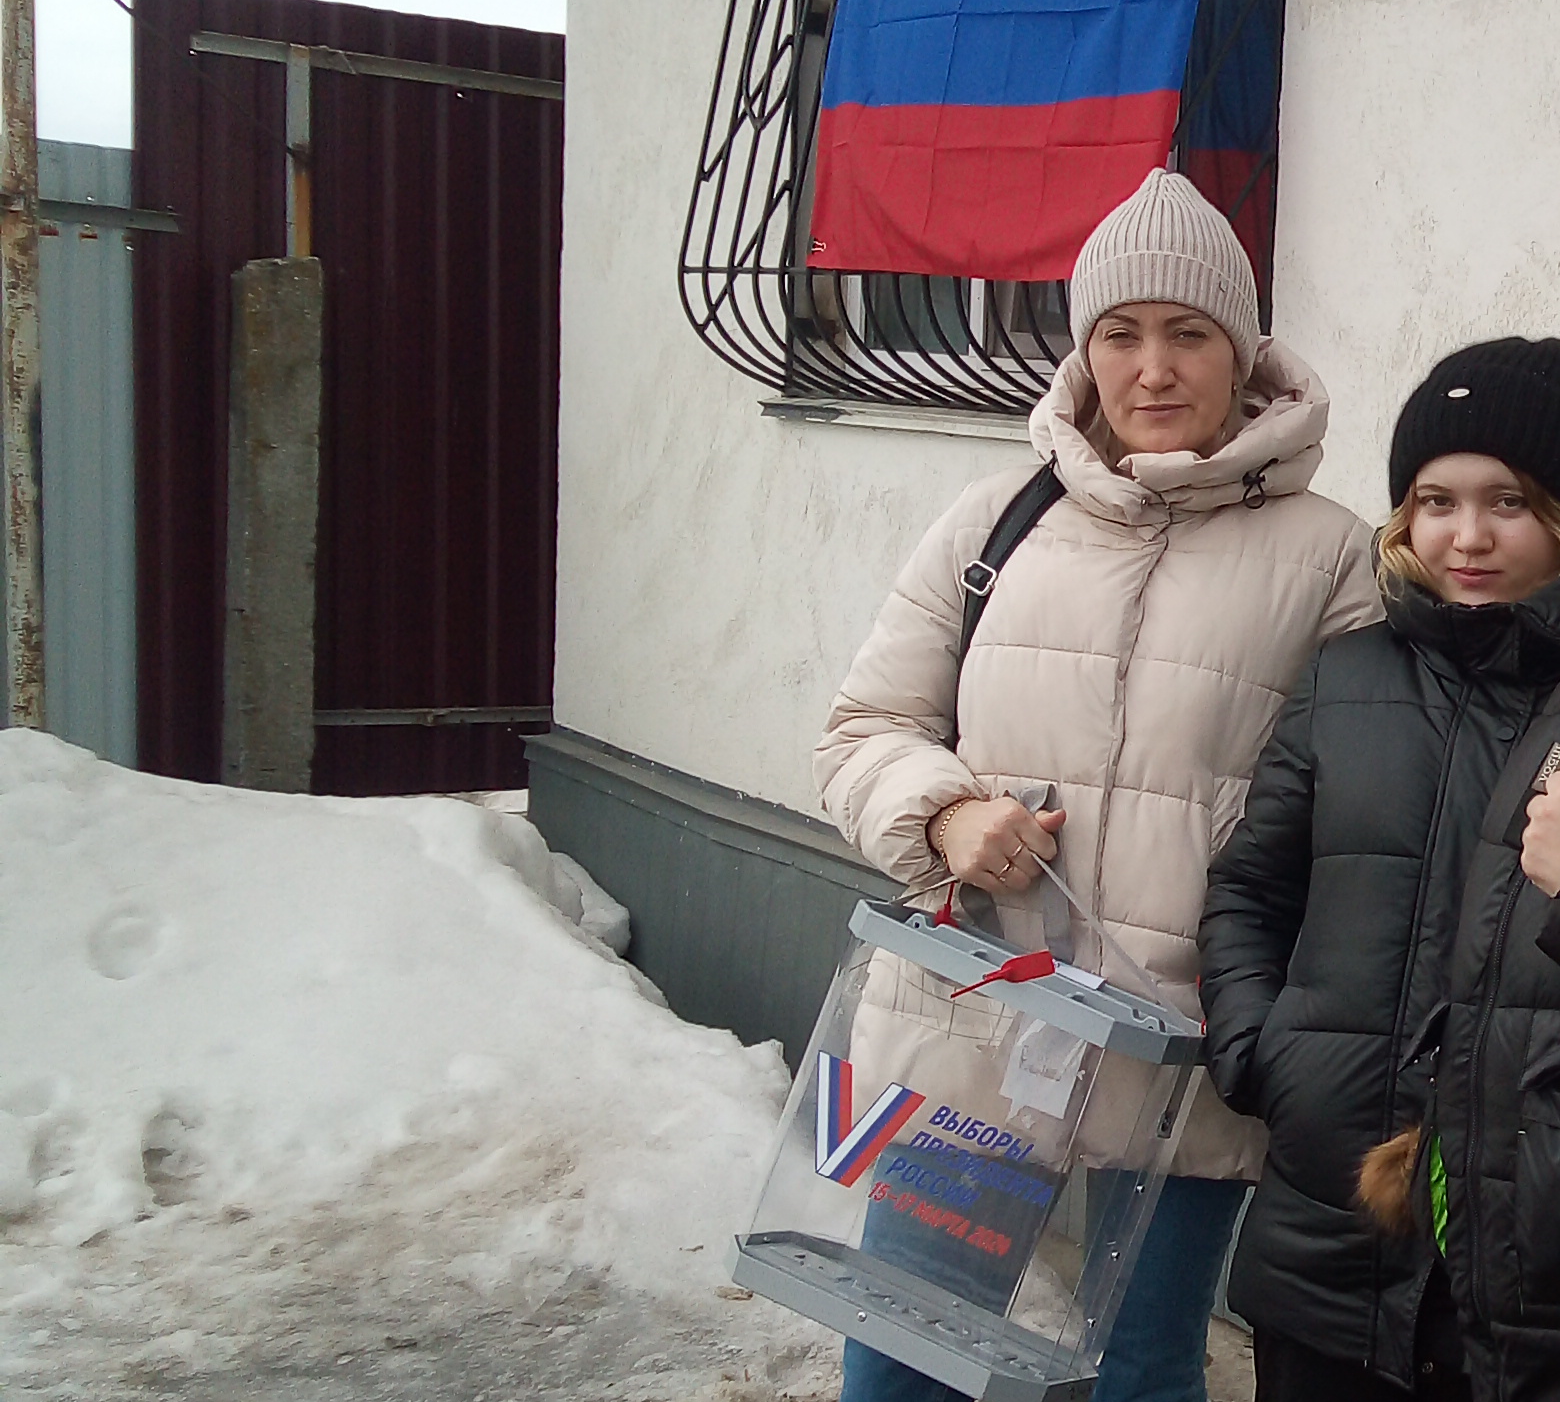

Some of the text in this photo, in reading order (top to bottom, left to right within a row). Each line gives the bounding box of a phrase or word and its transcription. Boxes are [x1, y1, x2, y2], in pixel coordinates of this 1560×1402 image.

[928, 1105, 1035, 1161] ВЫБОРЫ
[885, 1156, 983, 1210] РОССИИ
[909, 1131, 1054, 1208] ПРЕЗИДЕНТА
[911, 1200, 970, 1239] МАРТА
